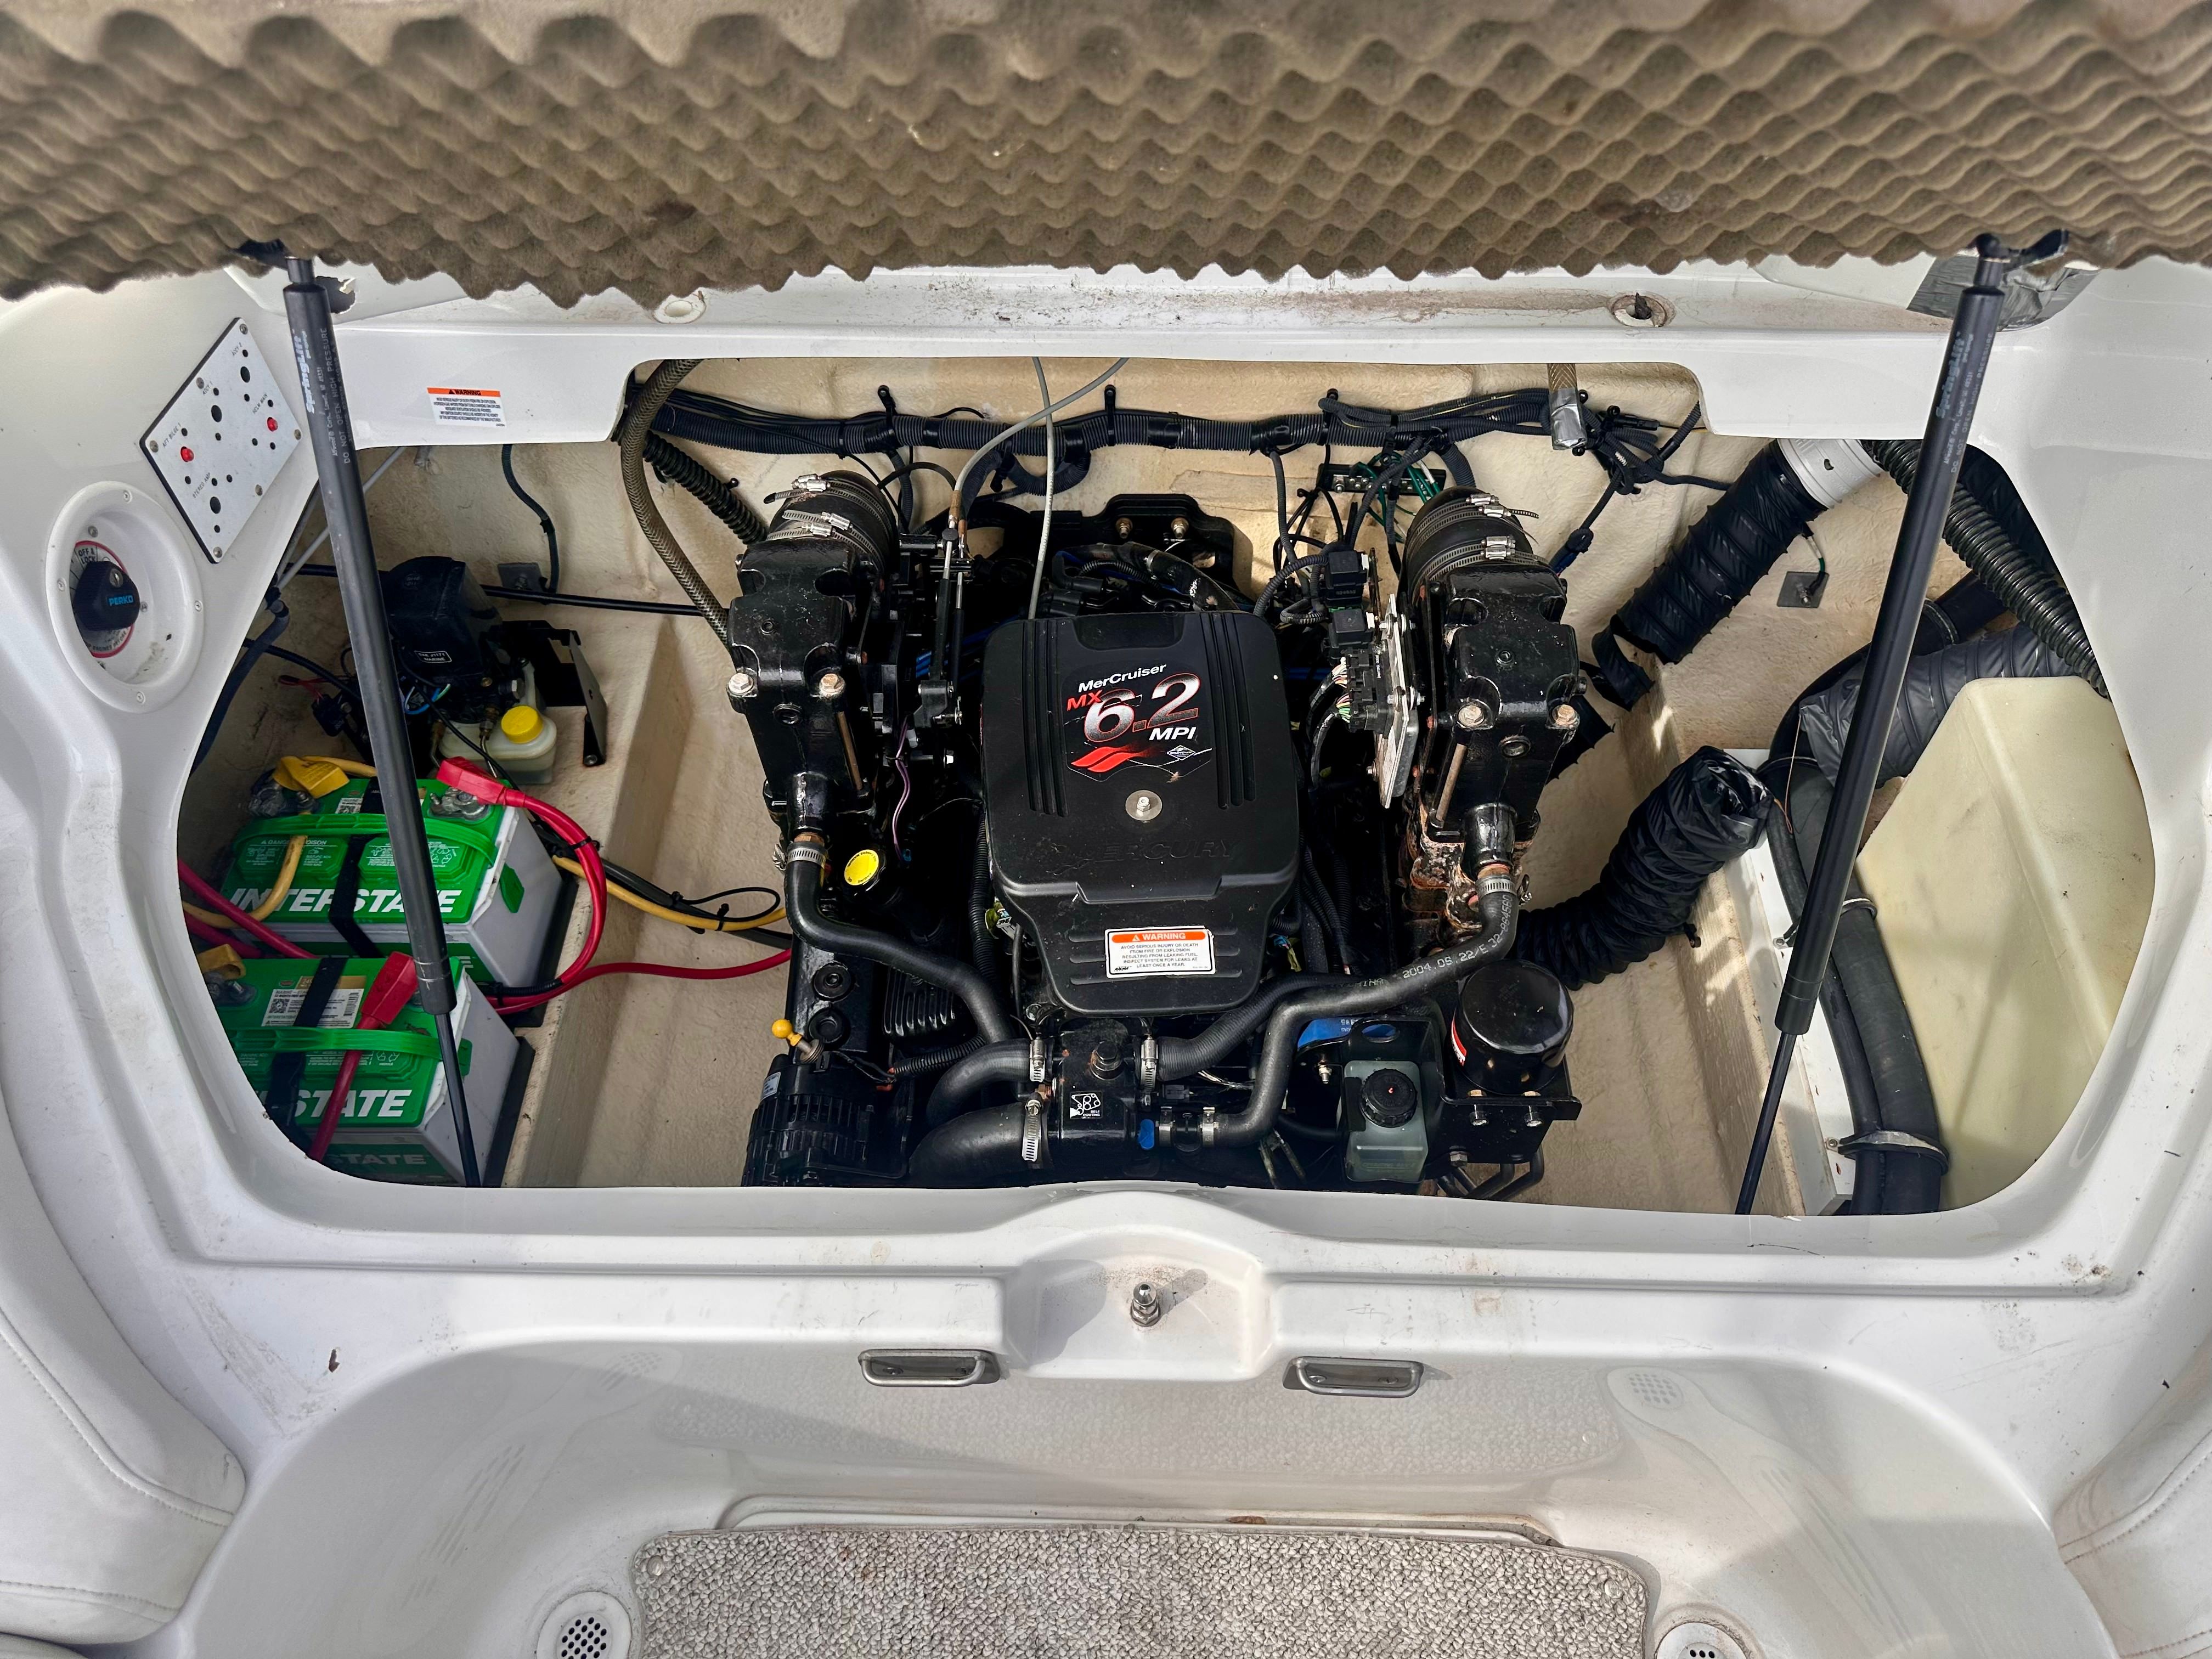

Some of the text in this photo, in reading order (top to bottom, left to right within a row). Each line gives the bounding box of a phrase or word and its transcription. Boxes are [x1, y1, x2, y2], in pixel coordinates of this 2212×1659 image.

[320, 328, 334, 373] PRESSURE
[330, 377, 338, 397] HIGH
[334, 403, 343, 425] OPEN
[339, 431, 347, 447] NOT
[1956, 439, 1965, 455] NOT
[1961, 410, 1972, 433] OPEN
[343, 452, 351, 464] DO
[78, 549, 89, 557] OFF
[108, 595, 134, 606] PERKO
[1078, 664, 1167, 693] MerCruiser
[1066, 673, 1201, 742] MX 6.2
[1149, 726, 1197, 741] MPI
[1142, 932, 1186, 940] WARNING
